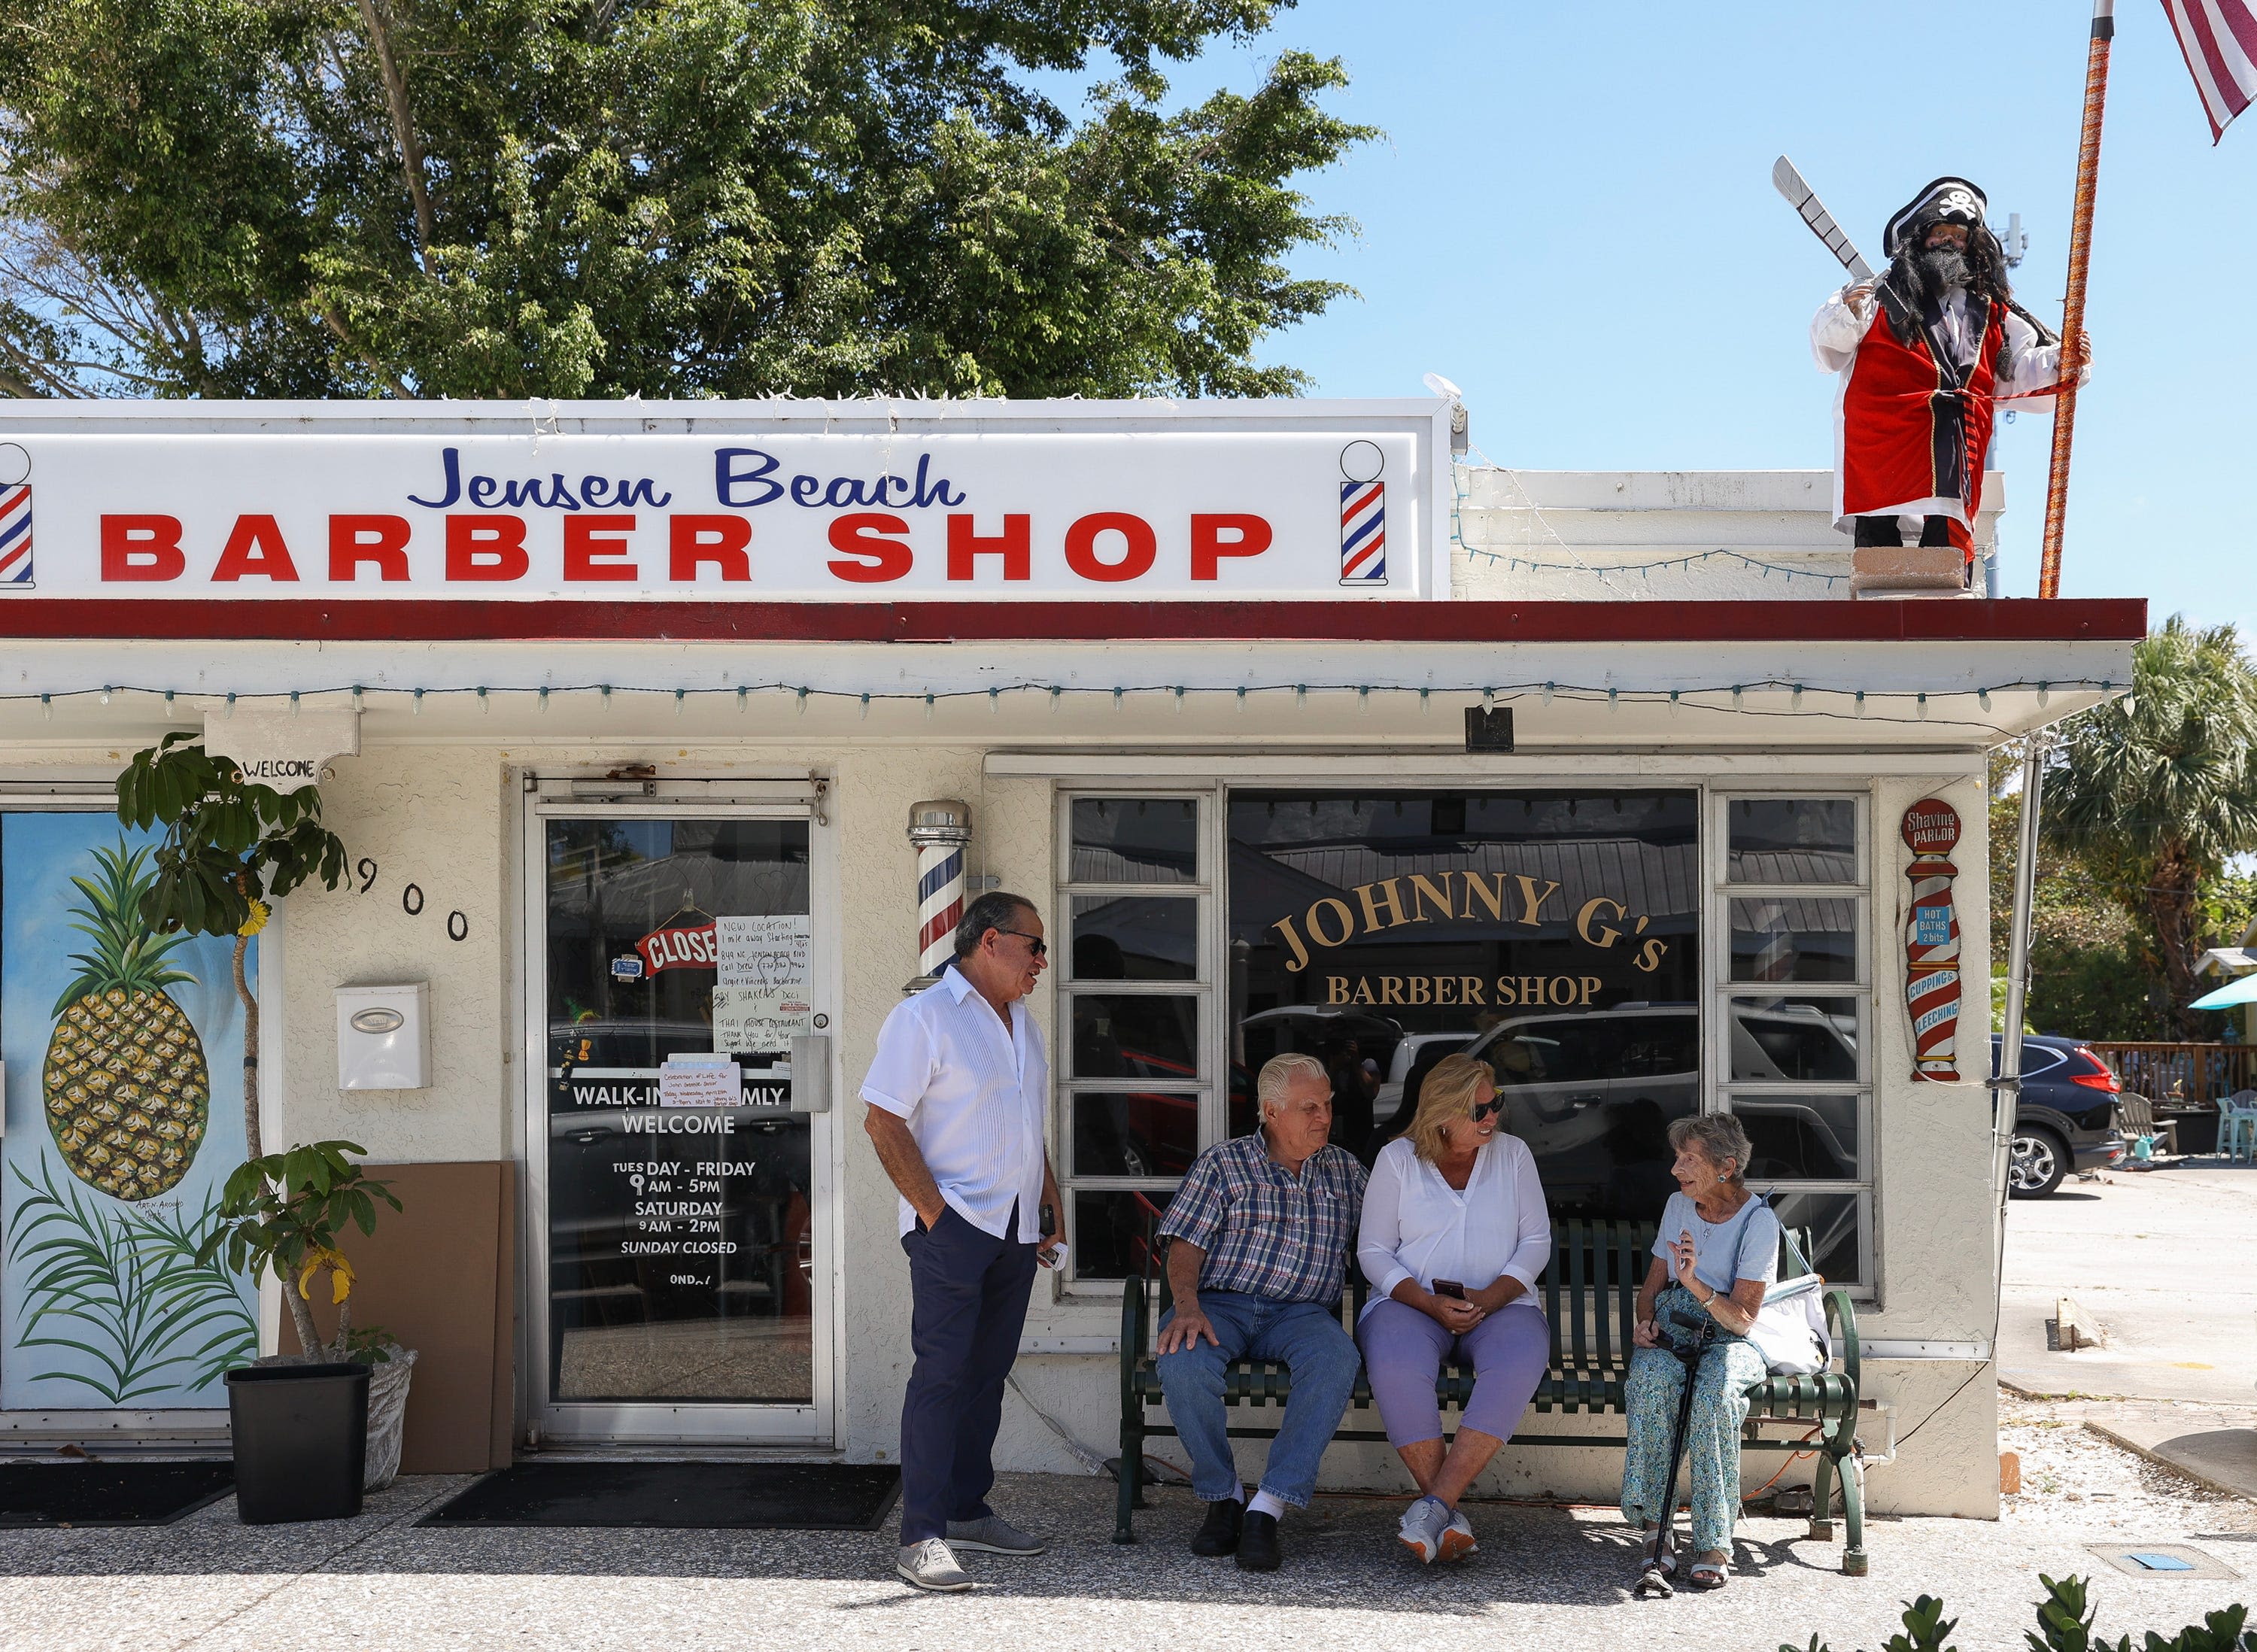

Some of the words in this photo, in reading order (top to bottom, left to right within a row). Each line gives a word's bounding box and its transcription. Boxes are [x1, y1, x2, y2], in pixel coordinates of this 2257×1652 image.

[408, 448, 672, 511] Jensen
[715, 448, 966, 509] Beach
[100, 514, 753, 582] BARBER
[827, 512, 1273, 583] SHOP
[242, 760, 314, 778] WELCOME
[1908, 812, 1955, 832] Shaving
[1914, 828, 1955, 847] PARLOR
[1271, 870, 1560, 973] JOHNNY
[1576, 897, 1669, 973] G's
[1924, 909, 1942, 919] HOT
[724, 922, 746, 932] NEW
[1919, 921, 1947, 931] BATHS
[728, 933, 741, 943] mile
[746, 934, 763, 944] away
[767, 933, 793, 946] Starting
[1923, 934, 1928, 942] 2
[1929, 933, 1944, 943] bits
[648, 927, 717, 969] CLOSE
[721, 962, 734, 971] Call
[1325, 976, 1487, 1006] BARBER
[1496, 976, 1602, 1006] SHOP
[718, 1018, 739, 1028] THAI
[1917, 1003, 1958, 1033] LEECHING
[621, 1115, 735, 1134] WELCOME
[696, 1162, 756, 1176] FRIDAY
[635, 1201, 723, 1216] SATURDAY
[688, 1219, 721, 1233] 2PM
[621, 1242, 679, 1254] SUNDAY
[682, 1241, 737, 1254] CLOSED
